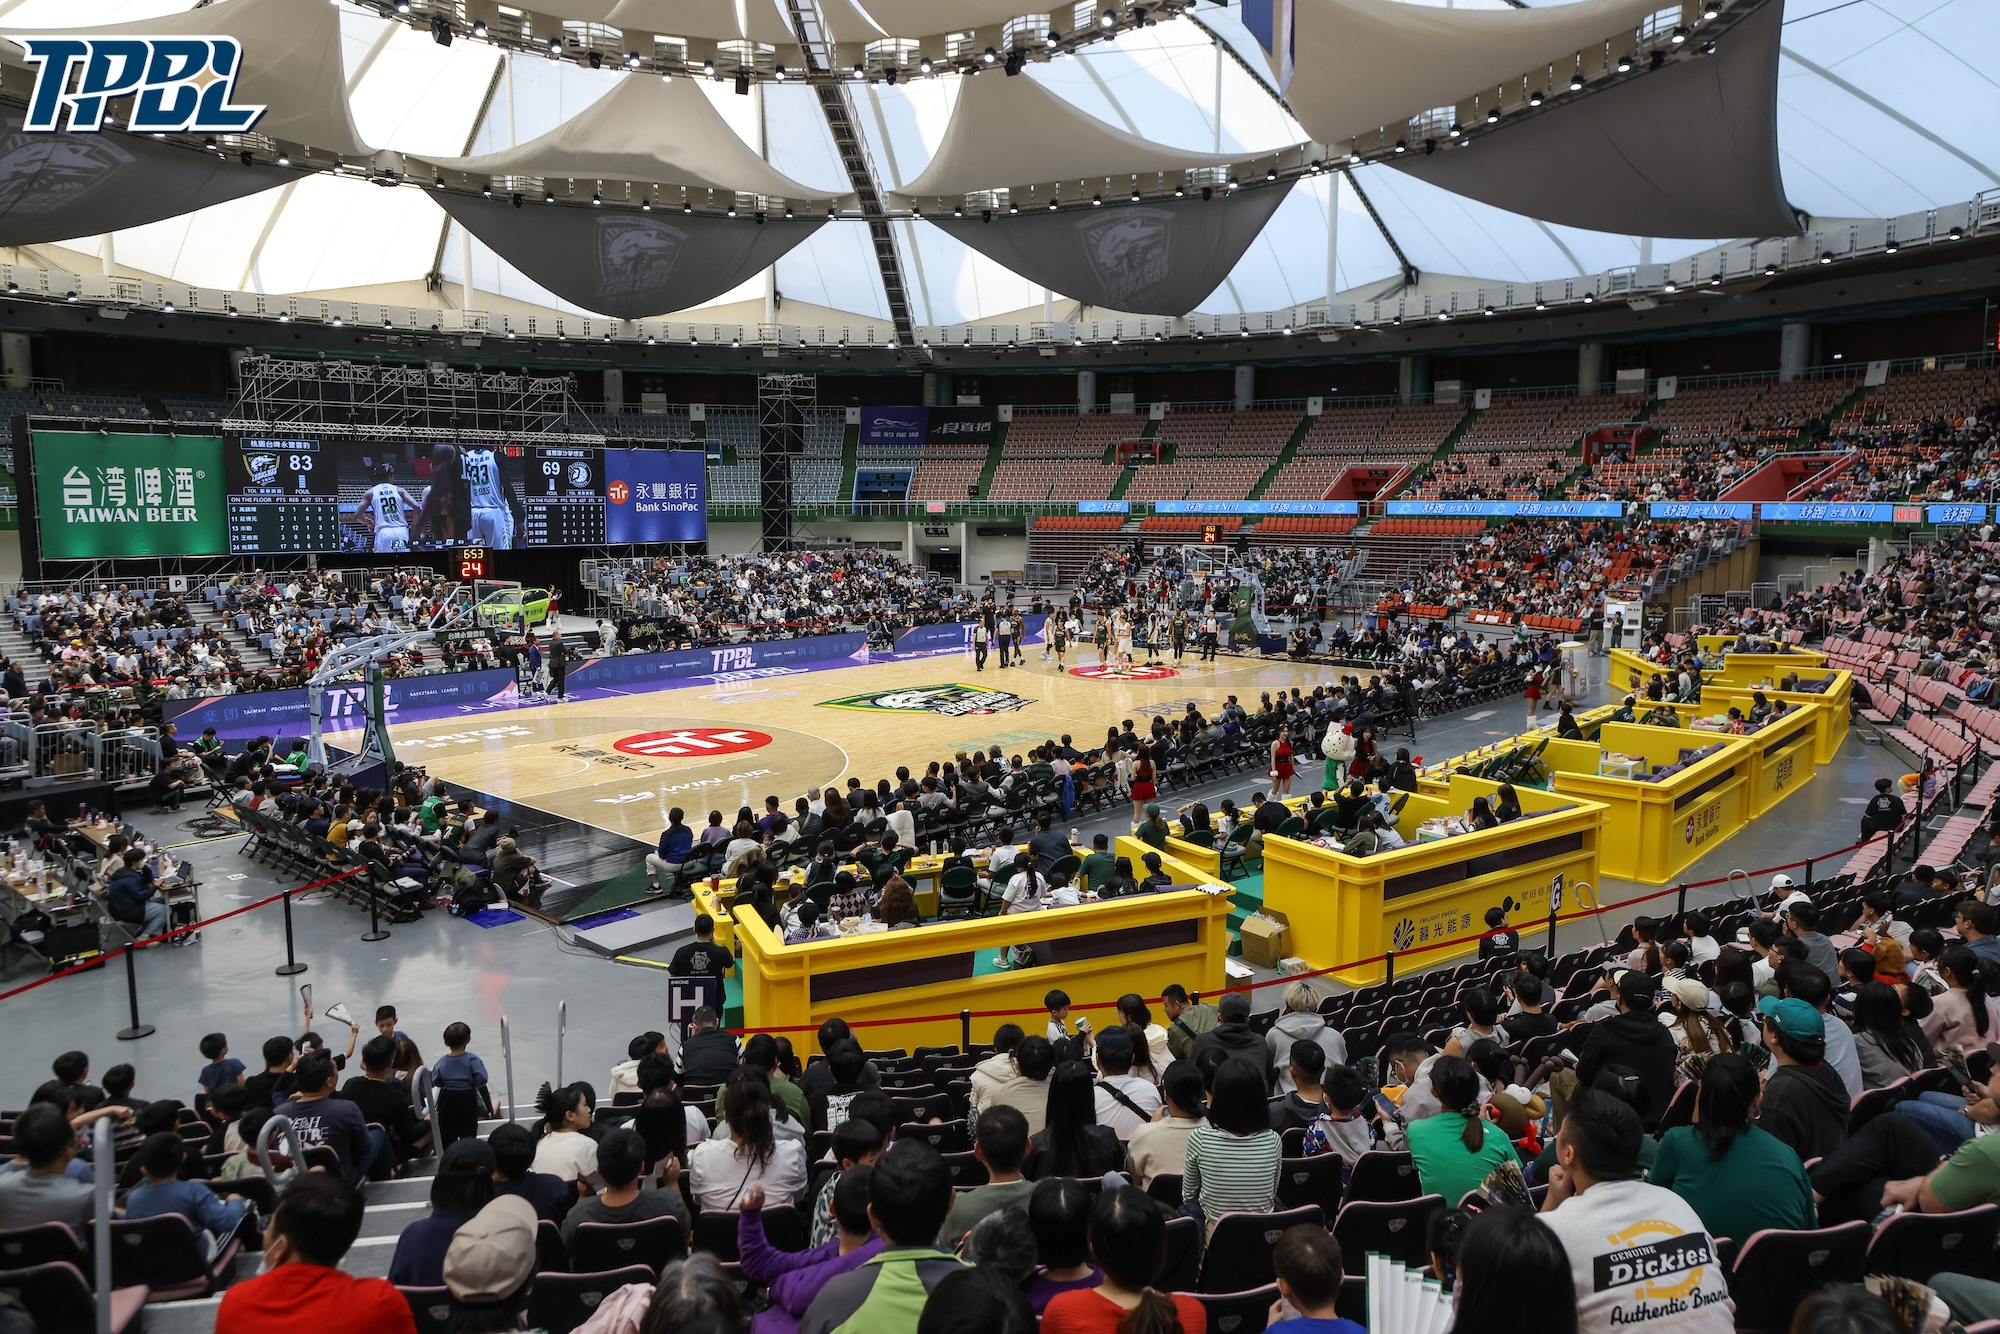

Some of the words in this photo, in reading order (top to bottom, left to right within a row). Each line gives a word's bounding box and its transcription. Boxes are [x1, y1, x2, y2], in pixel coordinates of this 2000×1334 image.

[289, 455, 313, 471] 83
[542, 461, 560, 475] 69
[471, 464, 490, 486] 33
[636, 482, 698, 499] 永豐銀行
[380, 497, 398, 515] 28
[636, 502, 660, 512] Bank
[661, 502, 698, 512] SinoPac
[1184, 503, 1205, 513] 舒跑
[1268, 503, 1289, 513] 舒跑
[1422, 503, 1446, 514] 舒跑
[1516, 503, 1541, 515] 舒跑
[1663, 504, 1690, 517] 舒跑
[1799, 505, 1827, 519] 舒跑
[63, 508, 139, 523] TAIWAN
[146, 507, 198, 522] BEER
[1204, 533, 1214, 542] 24
[464, 549, 484, 559] 6:53
[462, 562, 482, 577] 24
[710, 647, 758, 672] TPBL
[327, 684, 400, 717] TPL
[410, 689, 438, 697] BASKETBALL
[662, 777, 723, 793] WIN
[728, 768, 774, 783] AIR
[1697, 801, 1721, 832] 永豐銀行
[1420, 914, 1440, 924] TWILIGHT
[1442, 908, 1460, 918] ENERGY
[672, 986, 704, 1020] H
[1610, 1246, 1657, 1262] GENUINE
[1608, 1247, 1708, 1287] Dickies
[1611, 1297, 1689, 1326] Authentic
